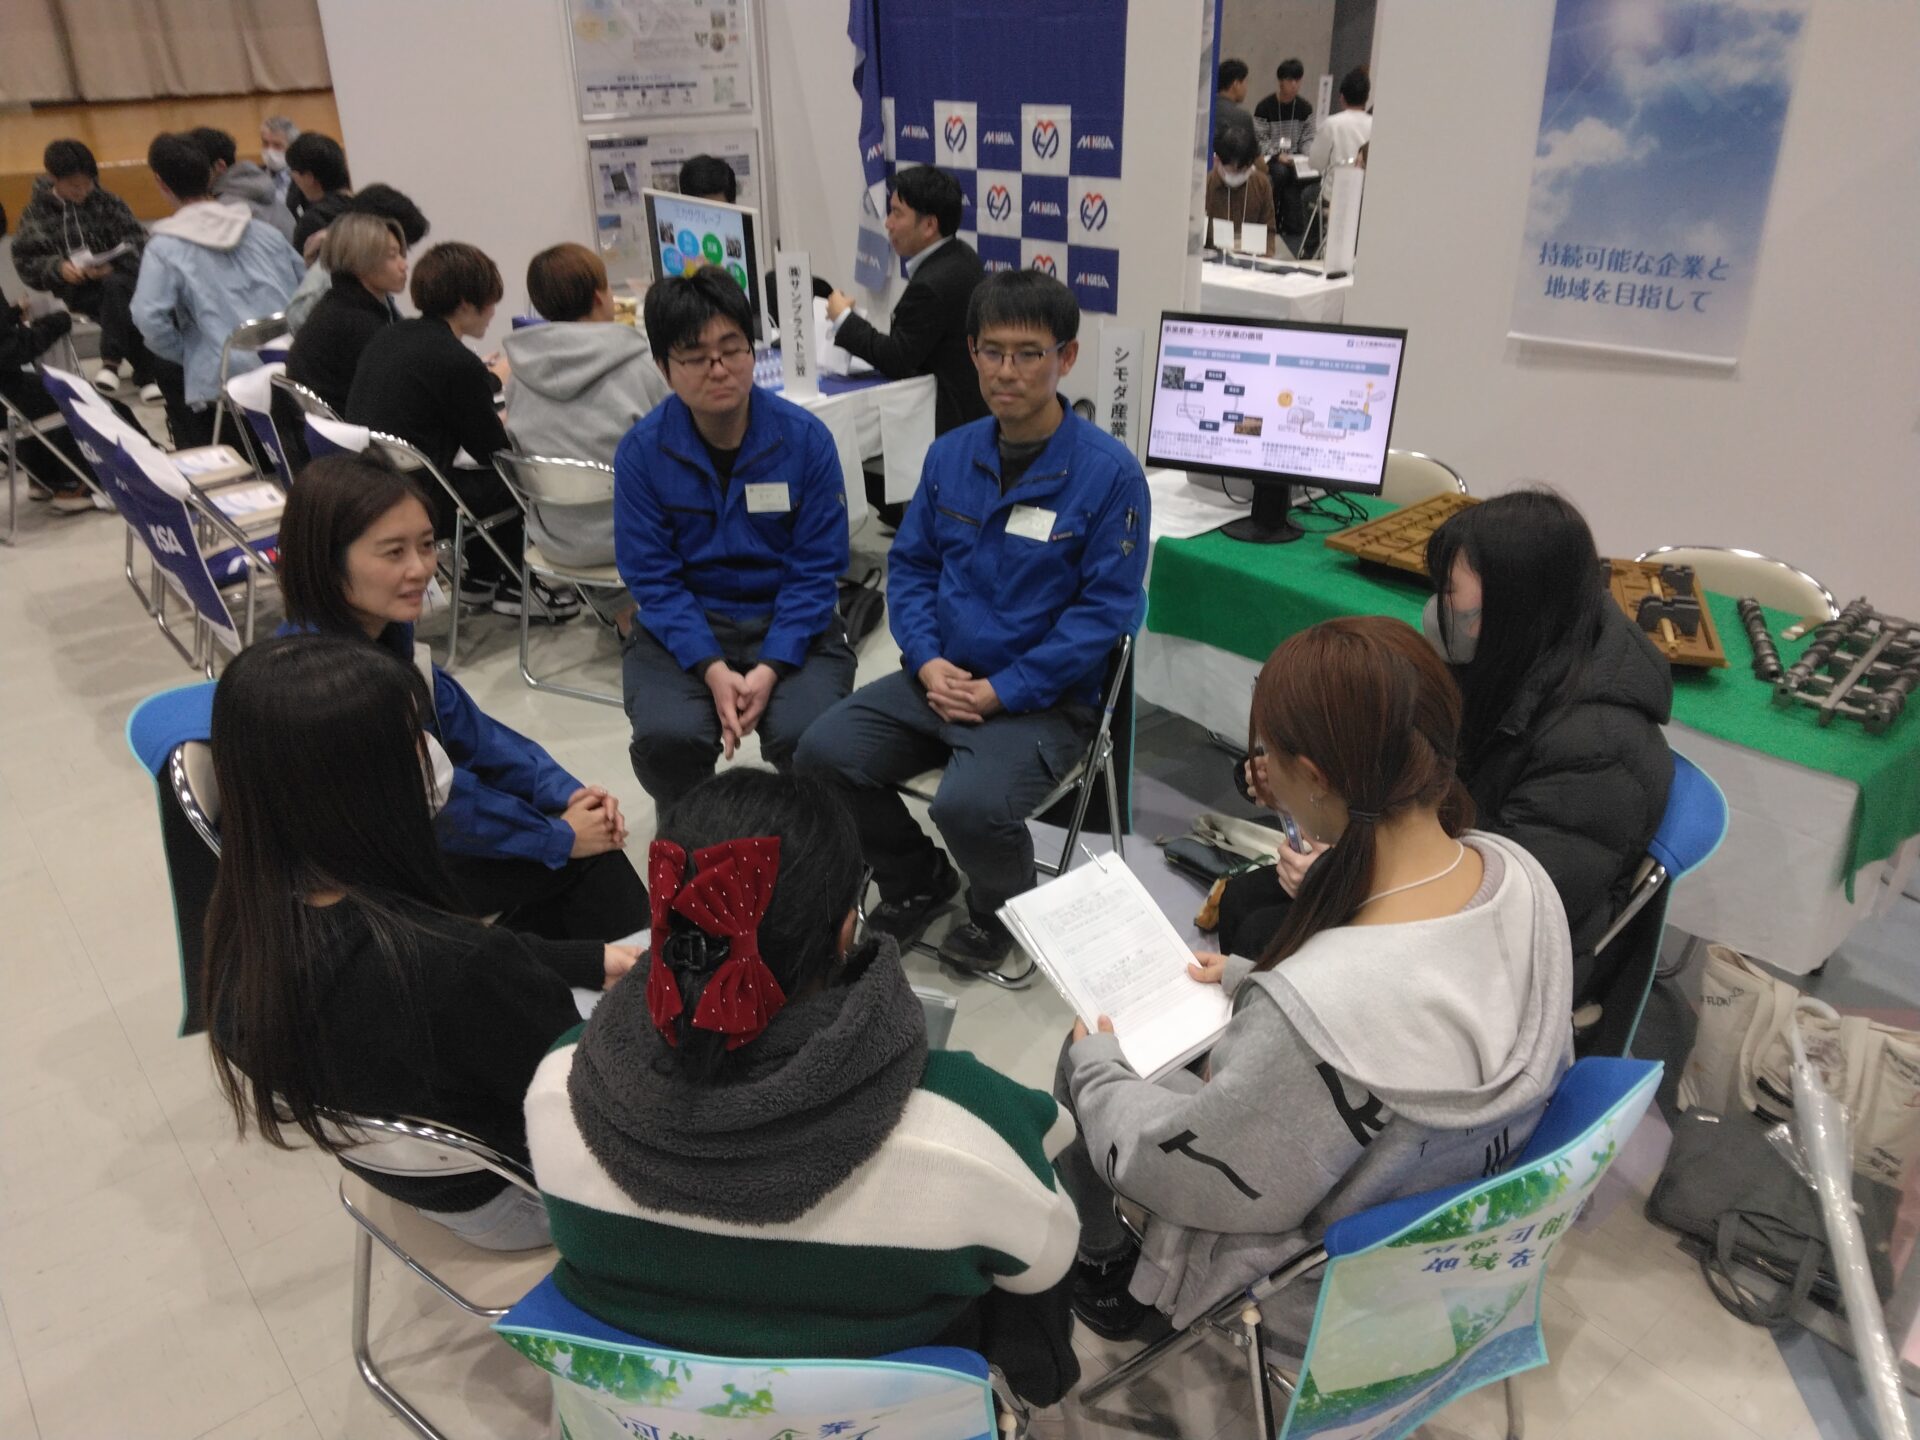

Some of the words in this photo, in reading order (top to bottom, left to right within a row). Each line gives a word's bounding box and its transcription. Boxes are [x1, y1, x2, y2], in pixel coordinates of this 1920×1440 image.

[900, 124, 930, 139] MIKASA
[983, 130, 1015, 146] MIKASA
[1076, 134, 1114, 150] MIKASA
[1029, 200, 1061, 217] MIKASA
[1538, 241, 1731, 282] 持続可能な企業と
[1075, 271, 1110, 289] MIKASA
[1544, 275, 1713, 313] 地域を目指して
[1096, 1296, 1120, 1309] AIR
